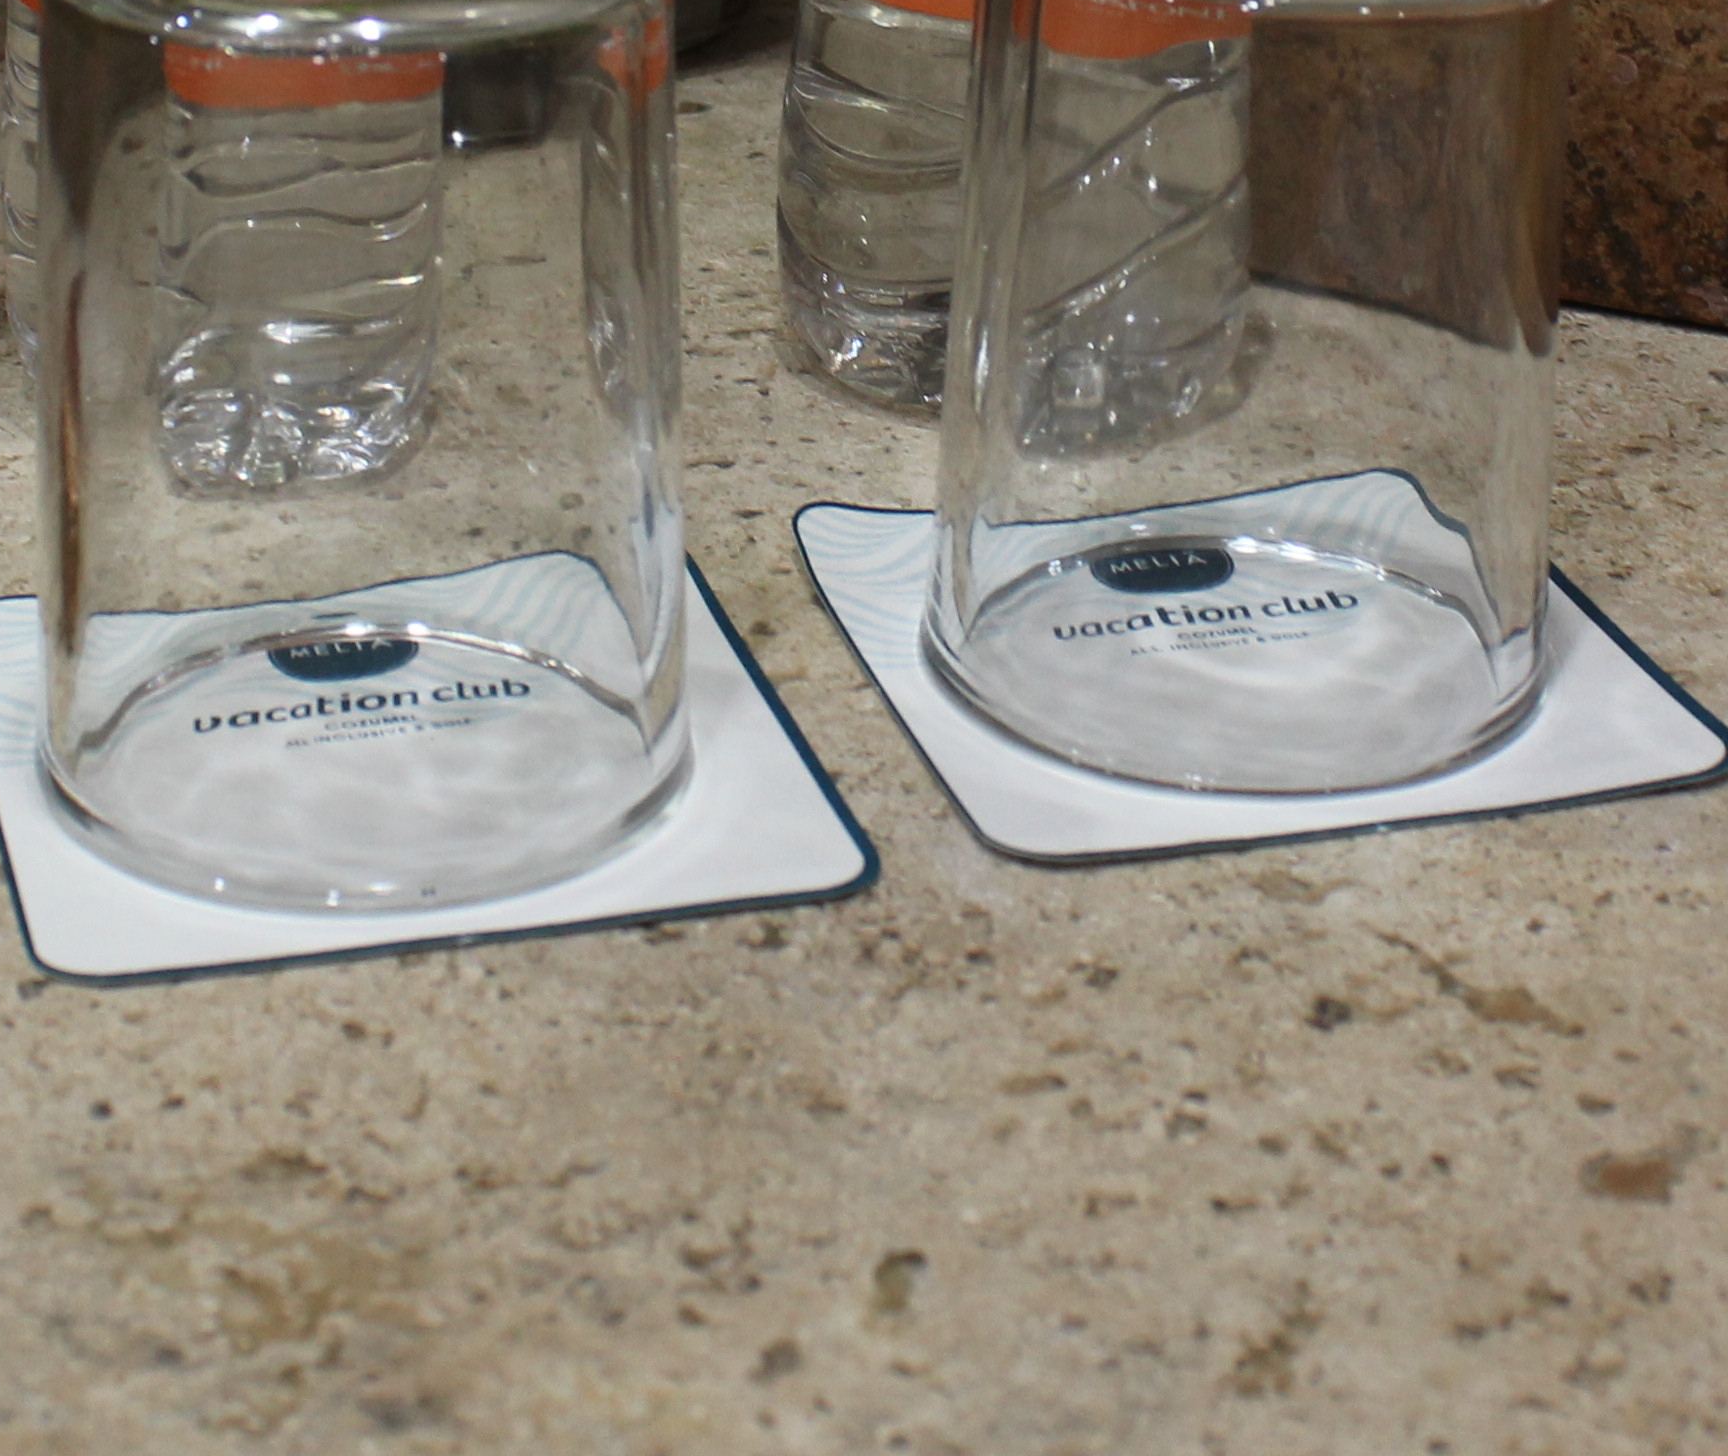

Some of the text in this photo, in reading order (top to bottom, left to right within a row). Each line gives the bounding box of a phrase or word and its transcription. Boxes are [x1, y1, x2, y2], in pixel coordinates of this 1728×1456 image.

[1053, 590, 1360, 641] vacation club
[193, 679, 531, 734] vacation club
